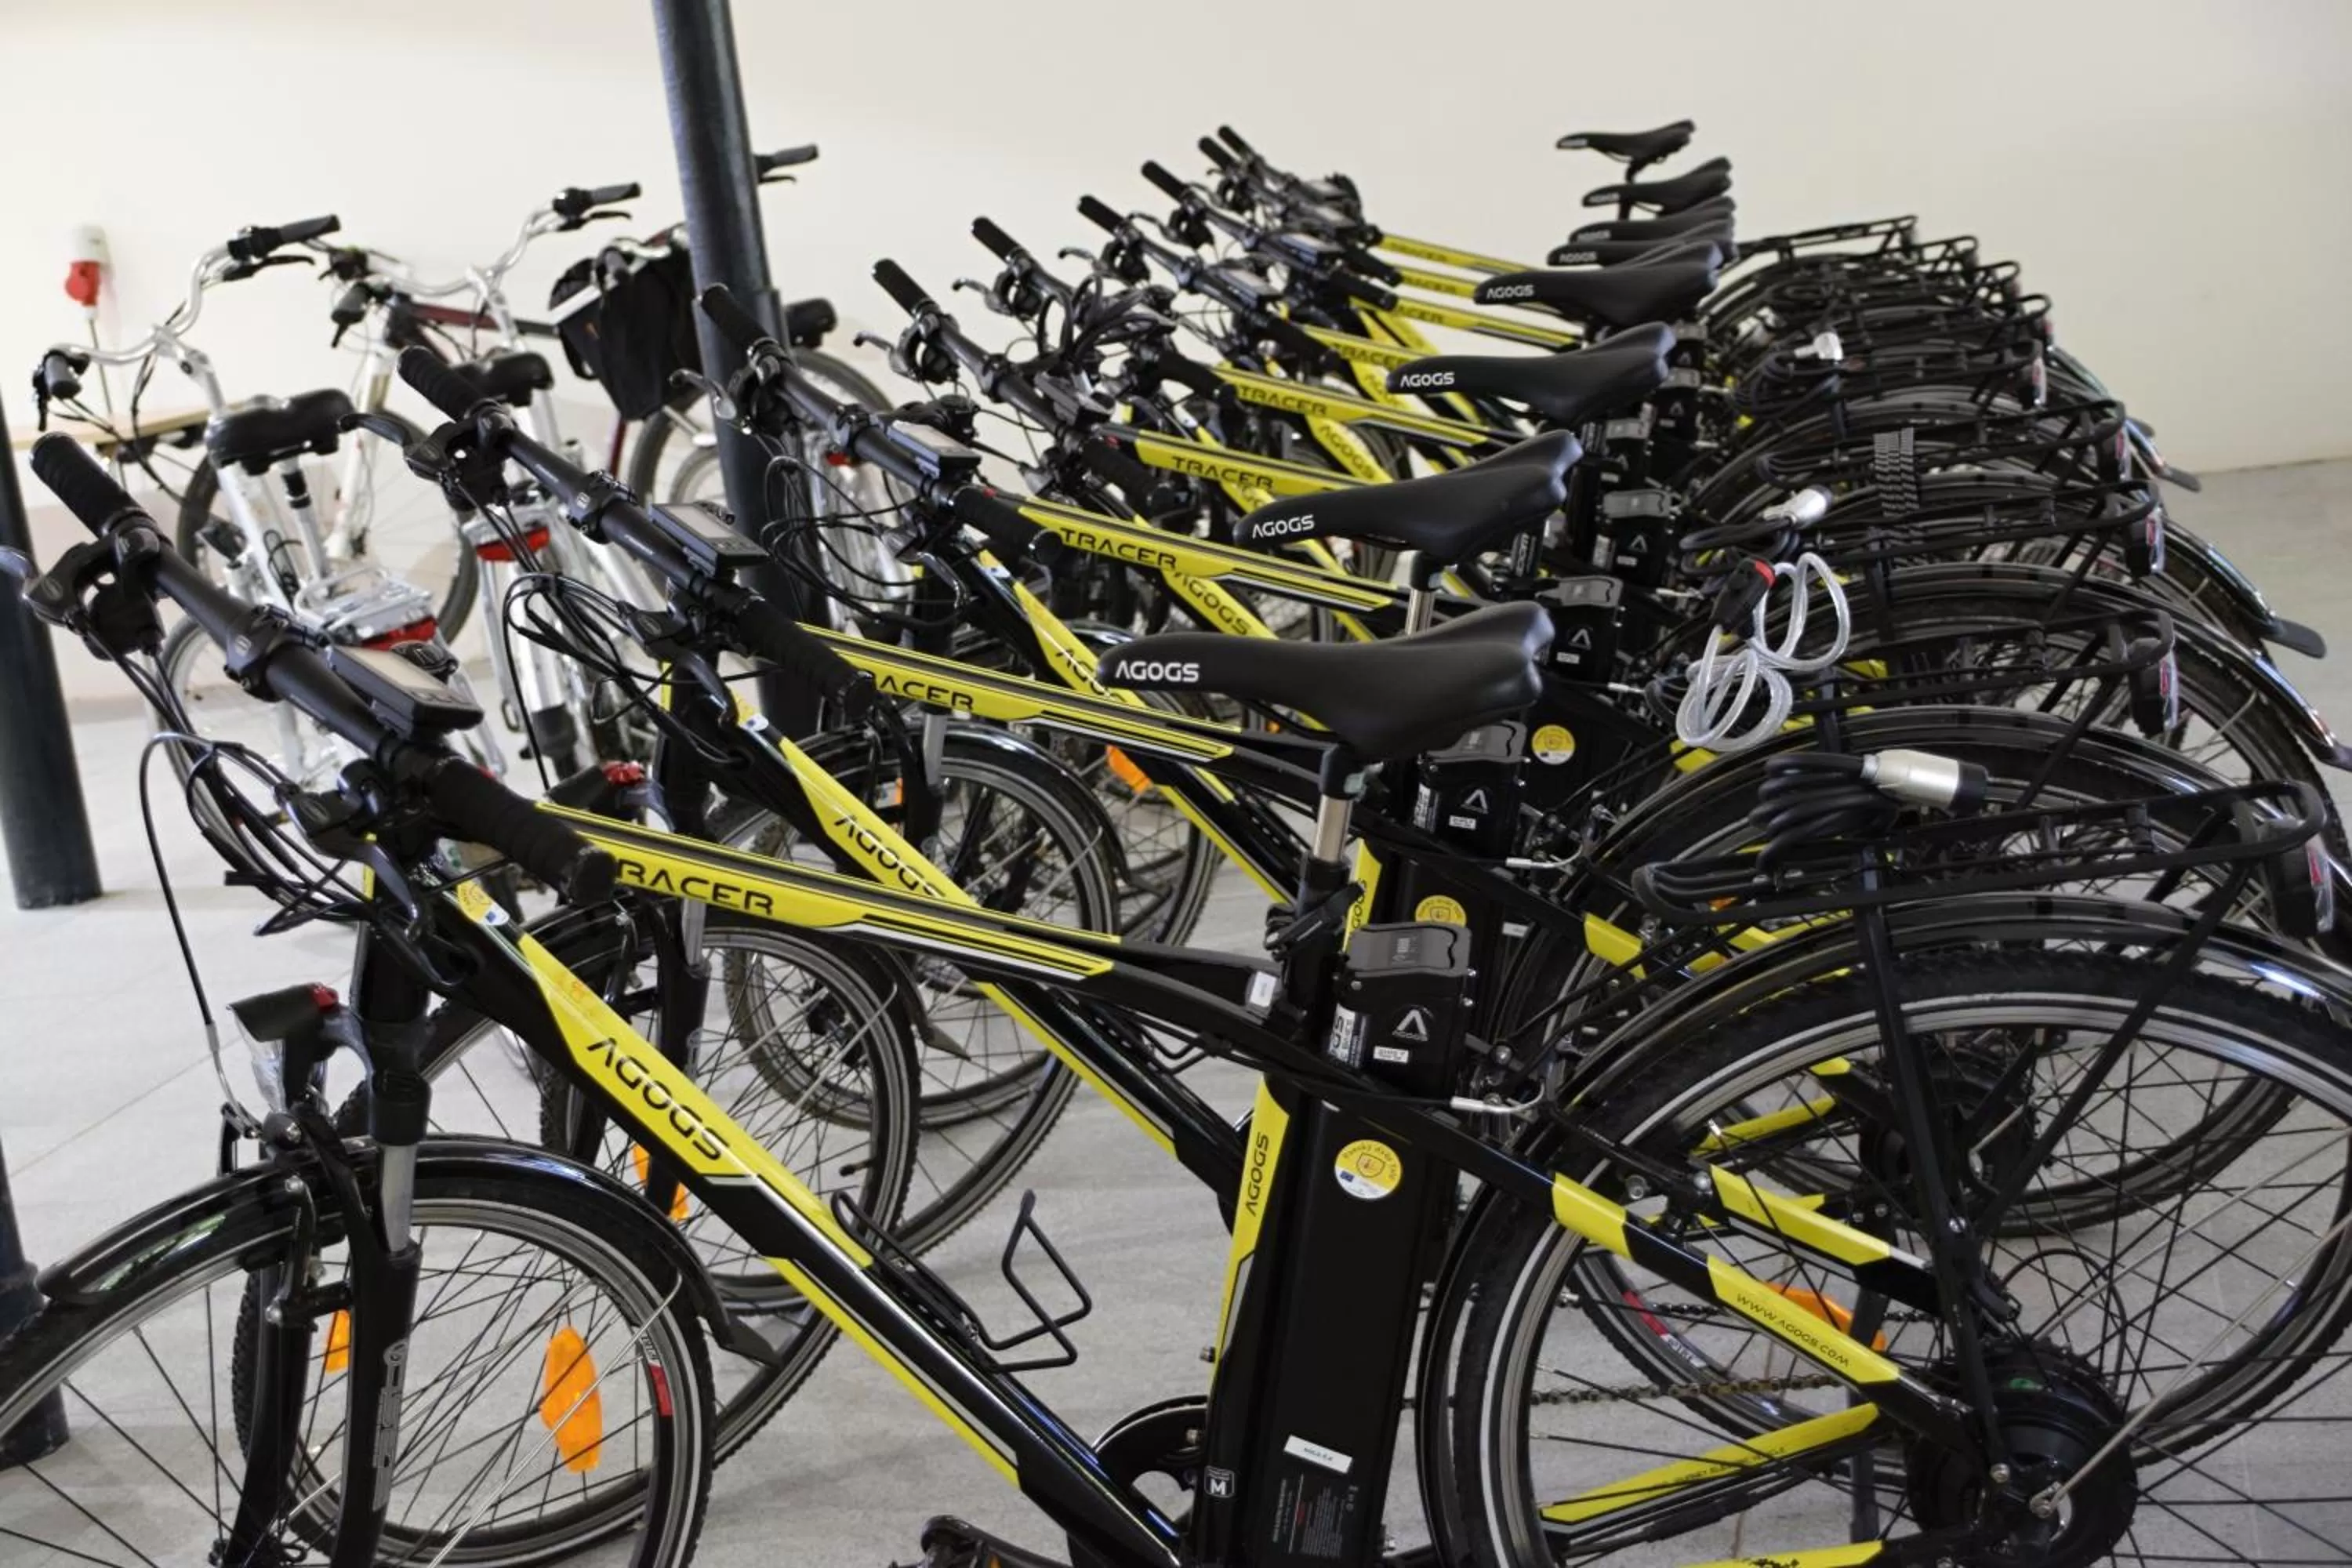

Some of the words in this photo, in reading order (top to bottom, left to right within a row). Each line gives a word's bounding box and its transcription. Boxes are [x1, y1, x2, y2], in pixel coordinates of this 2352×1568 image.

[1486, 284, 1534, 299] AGOGS
[1400, 371, 1455, 388] AGOGS
[1238, 386, 1327, 416] TRACER
[1320, 424, 1375, 480] AGOGS
[1171, 456, 1274, 490] TRACER
[1252, 514, 1316, 539] AGOGS
[1061, 526, 1177, 569] TRACER
[862, 667, 974, 710] ACER
[1115, 660, 1200, 683] AGOGS
[616, 858, 775, 916] RACER
[587, 1036, 729, 1162] AGOGS
[1245, 1131, 1269, 1217] AGOGS
[1210, 1478, 1227, 1495] M
